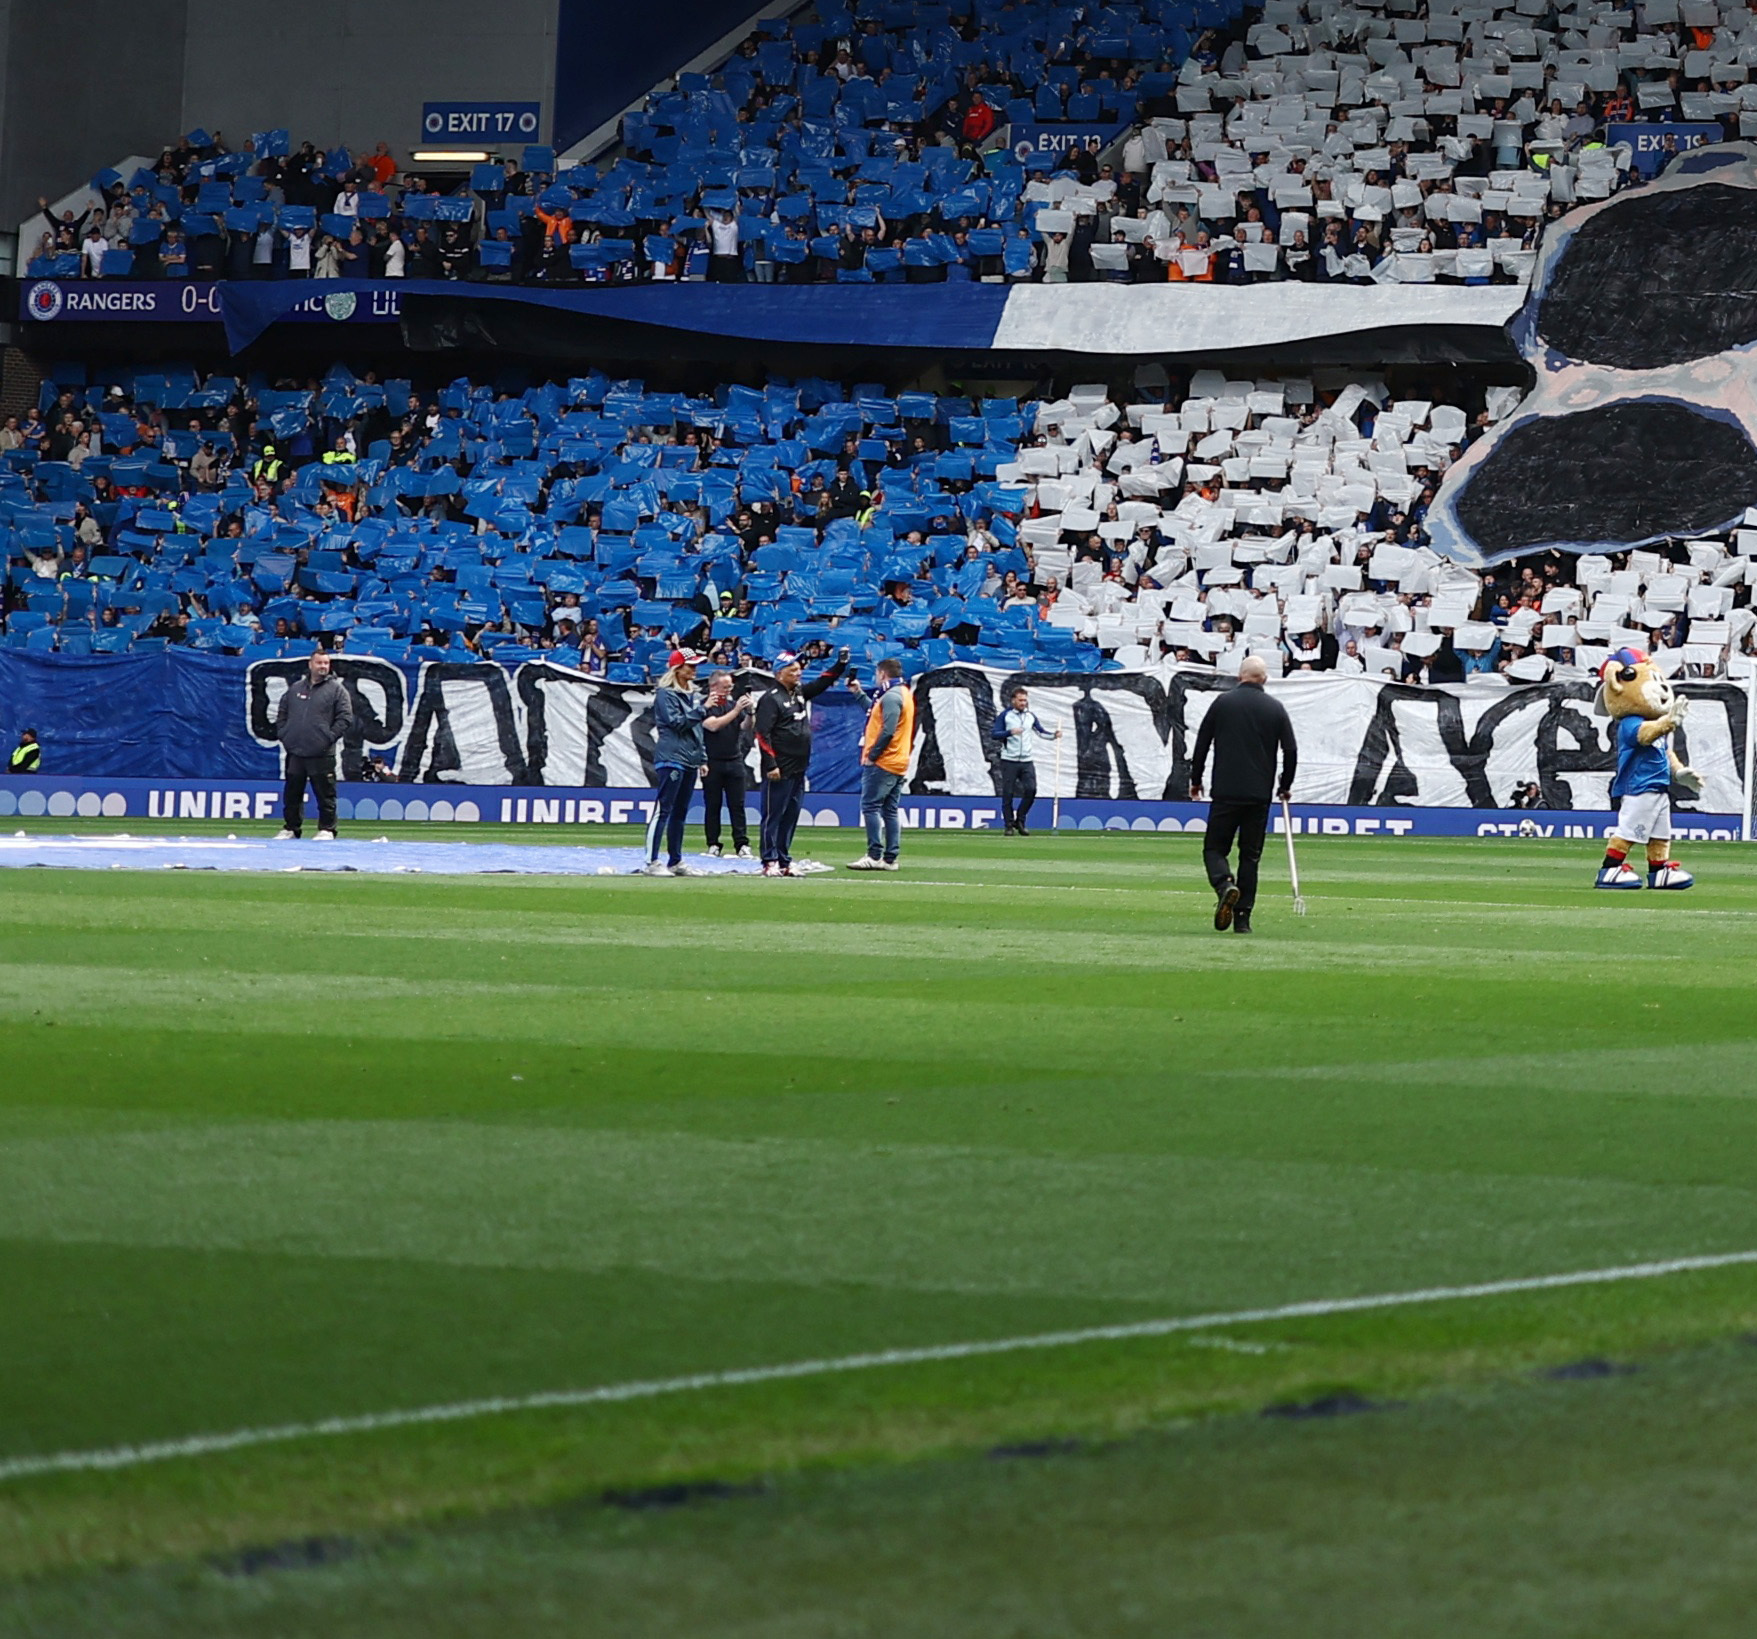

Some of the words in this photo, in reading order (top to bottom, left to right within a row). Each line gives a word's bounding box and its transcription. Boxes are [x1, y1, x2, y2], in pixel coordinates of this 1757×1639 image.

[448, 113, 491, 132] EXIT
[495, 113, 515, 132] 17
[1038, 133, 1078, 151] EXIT
[67, 292, 156, 311] RANGERS
[148, 790, 309, 819] UNIBE
